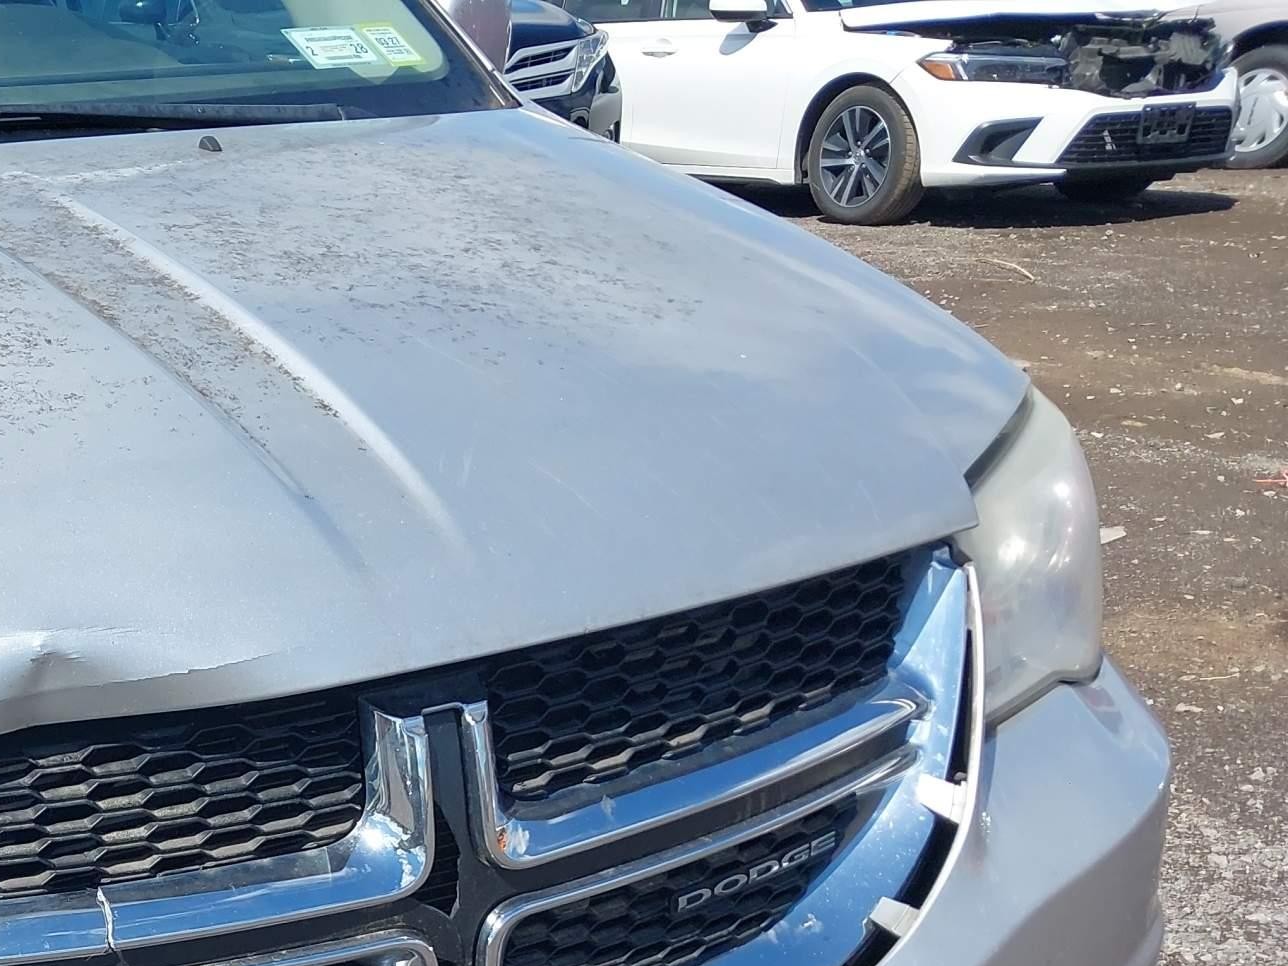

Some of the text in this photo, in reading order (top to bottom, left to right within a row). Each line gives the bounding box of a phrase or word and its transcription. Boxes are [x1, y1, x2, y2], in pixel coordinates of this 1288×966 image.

[306, 46, 319, 56] 2
[350, 43, 368, 54] 28
[677, 829, 837, 912] DODGE
